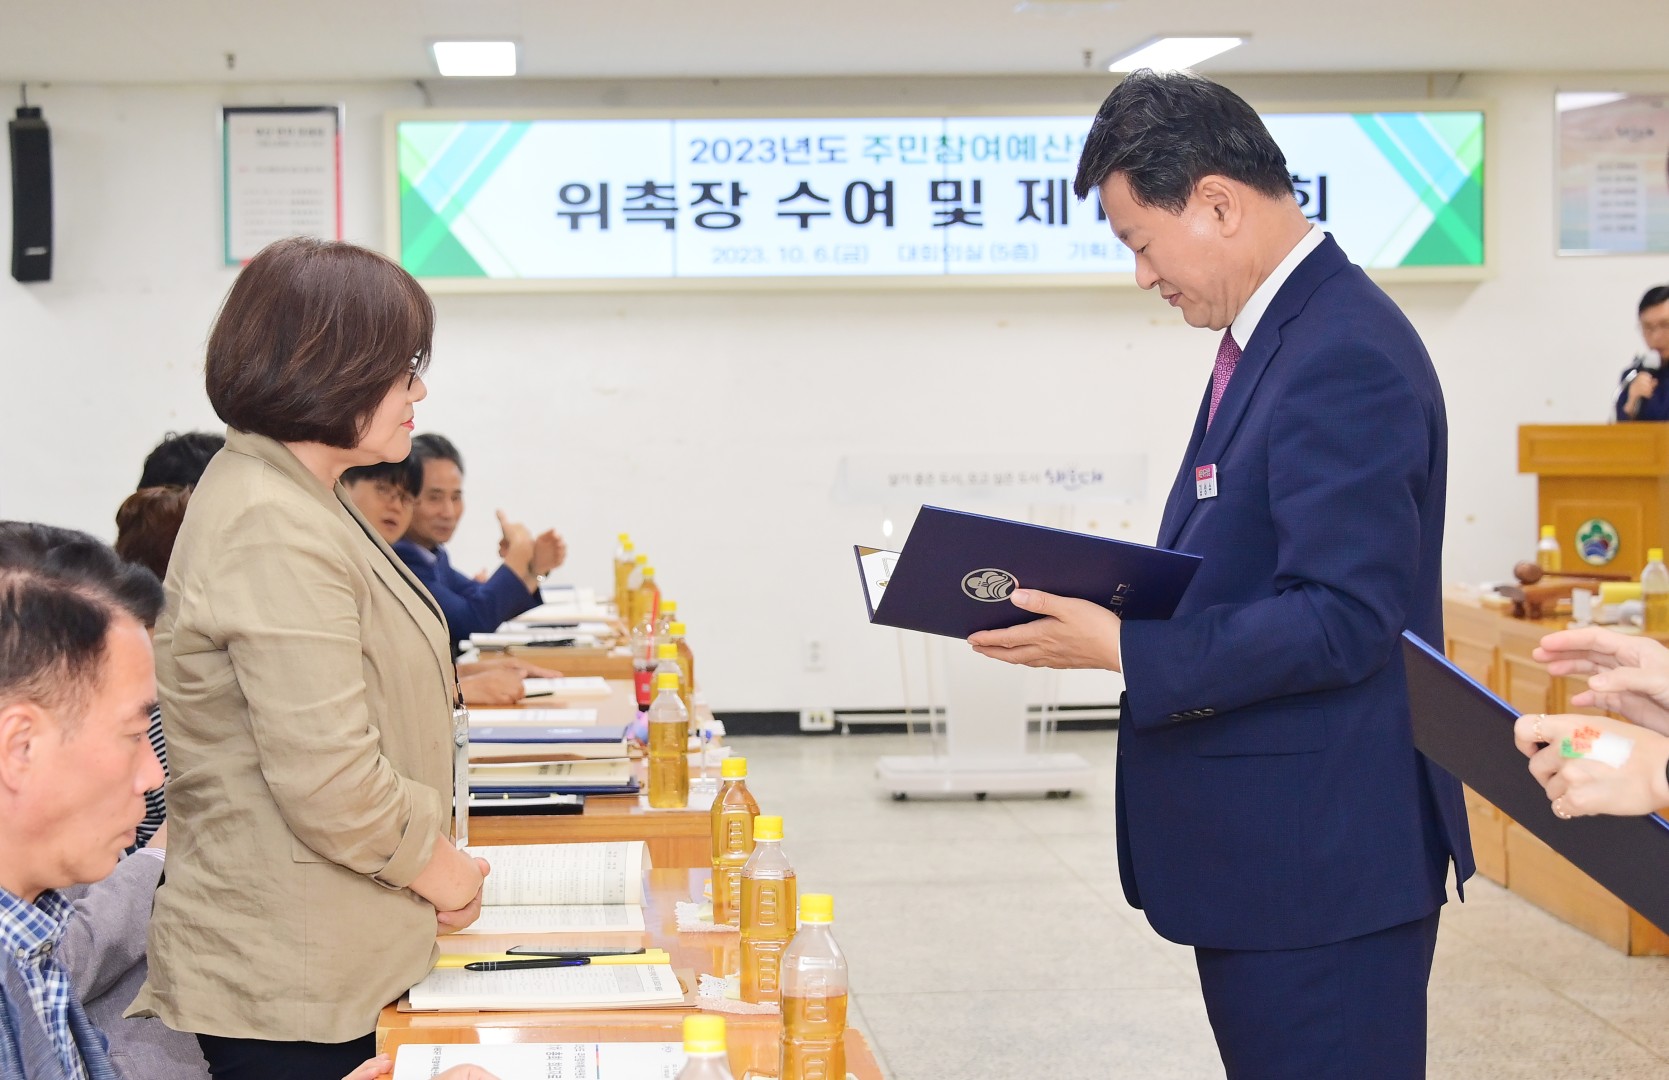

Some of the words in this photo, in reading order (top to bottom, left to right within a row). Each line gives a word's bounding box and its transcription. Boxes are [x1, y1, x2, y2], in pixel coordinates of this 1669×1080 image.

[690, 135, 847, 165] 2023년도
[862, 133, 1091, 166] 주민참여예산
[557, 180, 749, 231] 위촉장
[776, 180, 895, 230] 수여
[929, 179, 984, 228] 및
